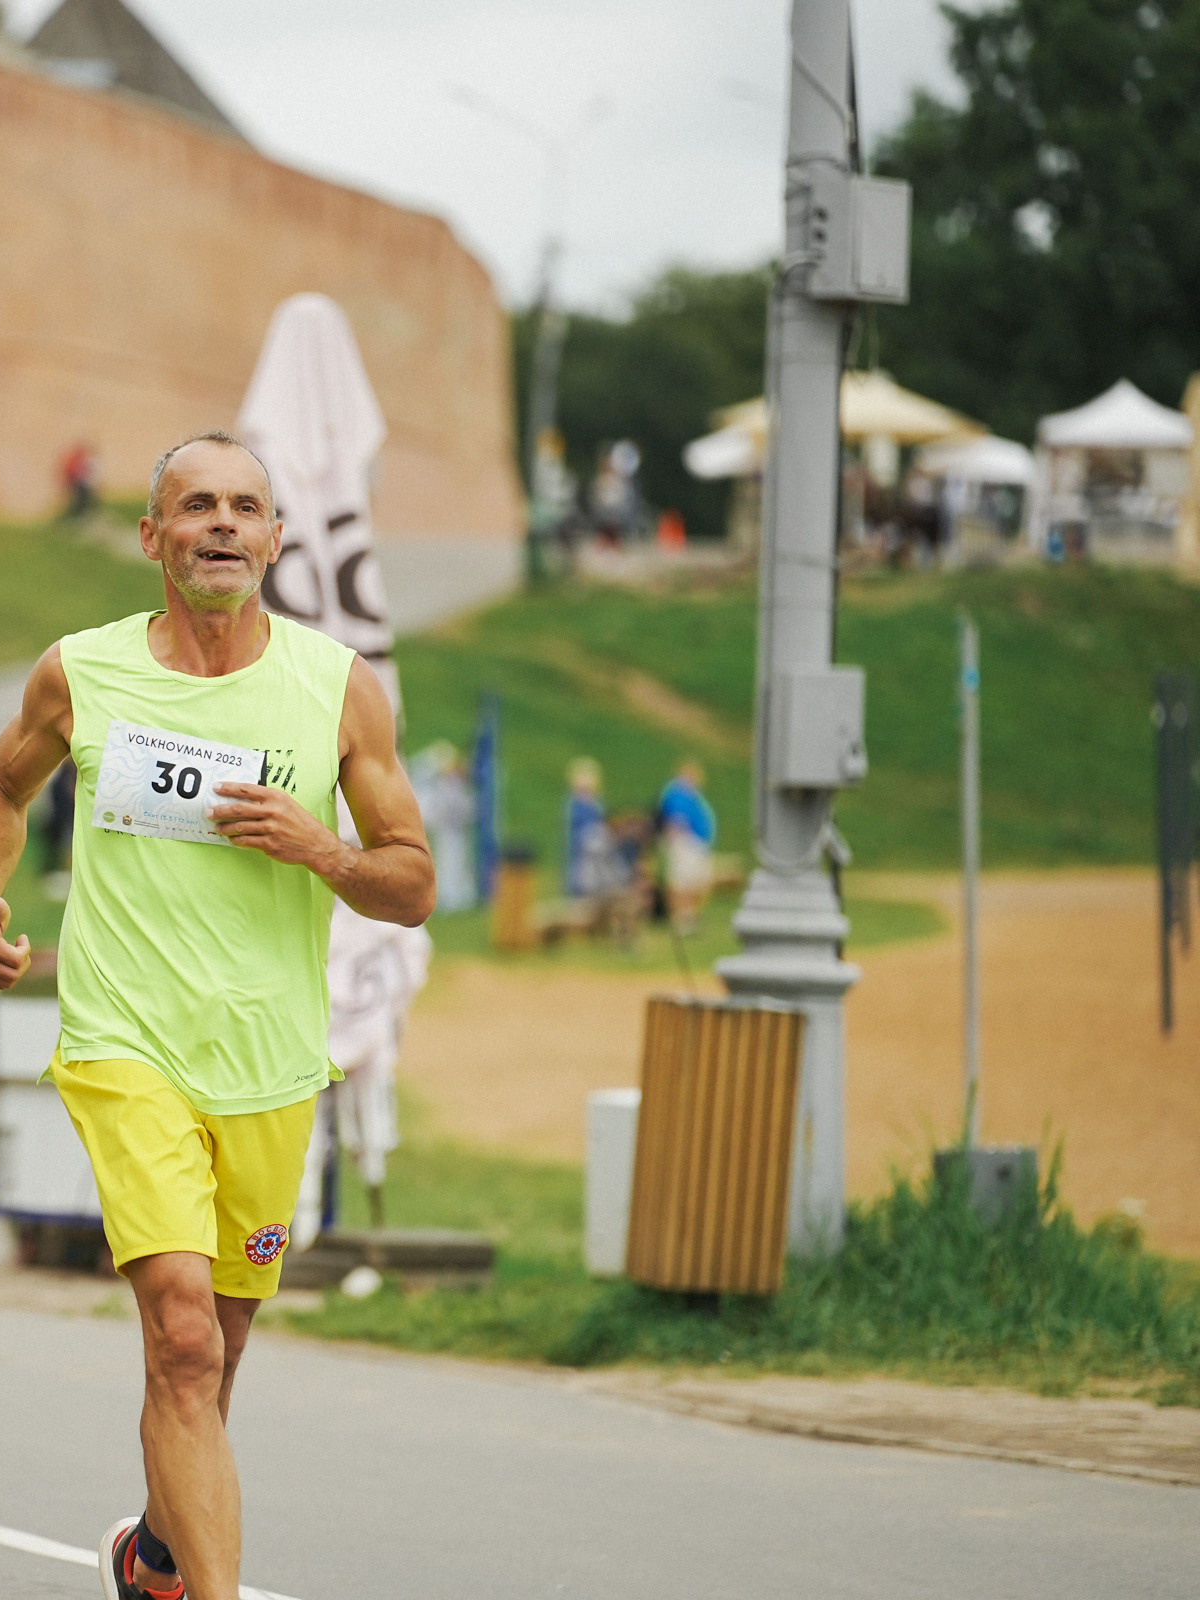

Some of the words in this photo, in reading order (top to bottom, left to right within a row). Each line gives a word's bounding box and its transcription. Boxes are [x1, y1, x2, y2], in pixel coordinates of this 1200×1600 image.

[128, 733, 212, 760] VOLKHOVMAN
[215, 752, 243, 767] 2023
[151, 760, 203, 800] 30
[247, 1247, 282, 1263] РОССИИ
